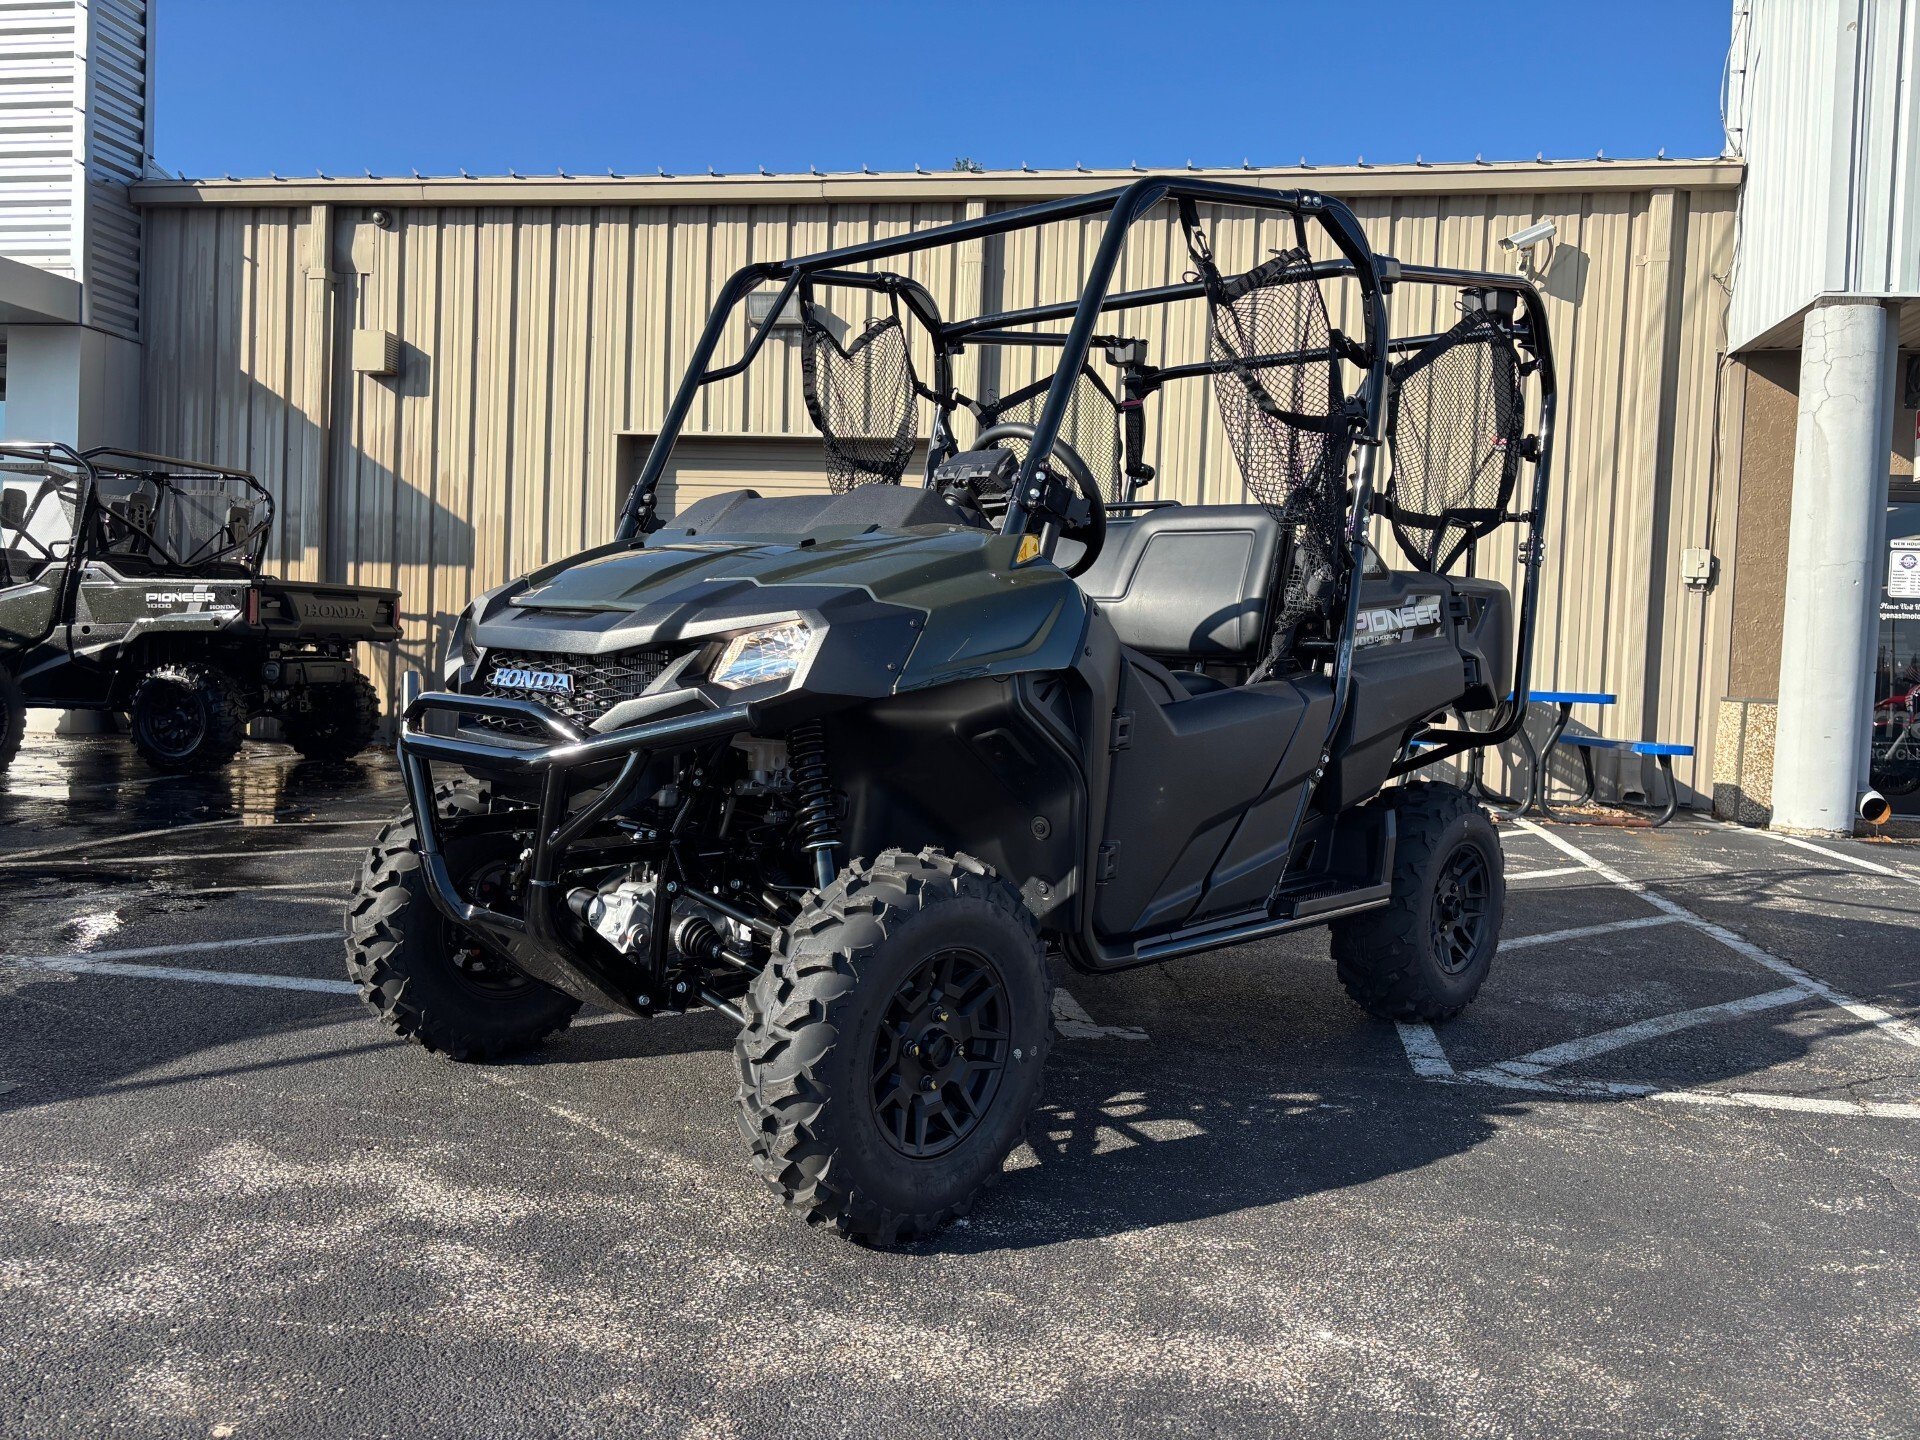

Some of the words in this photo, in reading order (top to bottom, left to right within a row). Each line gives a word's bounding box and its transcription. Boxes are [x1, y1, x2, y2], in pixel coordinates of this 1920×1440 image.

[145, 592, 215, 602] PIONEER
[304, 603, 368, 619] HONDA
[1879, 602, 1899, 610] Please
[1356, 604, 1441, 632] PIONEER
[491, 667, 570, 691] HONDA
